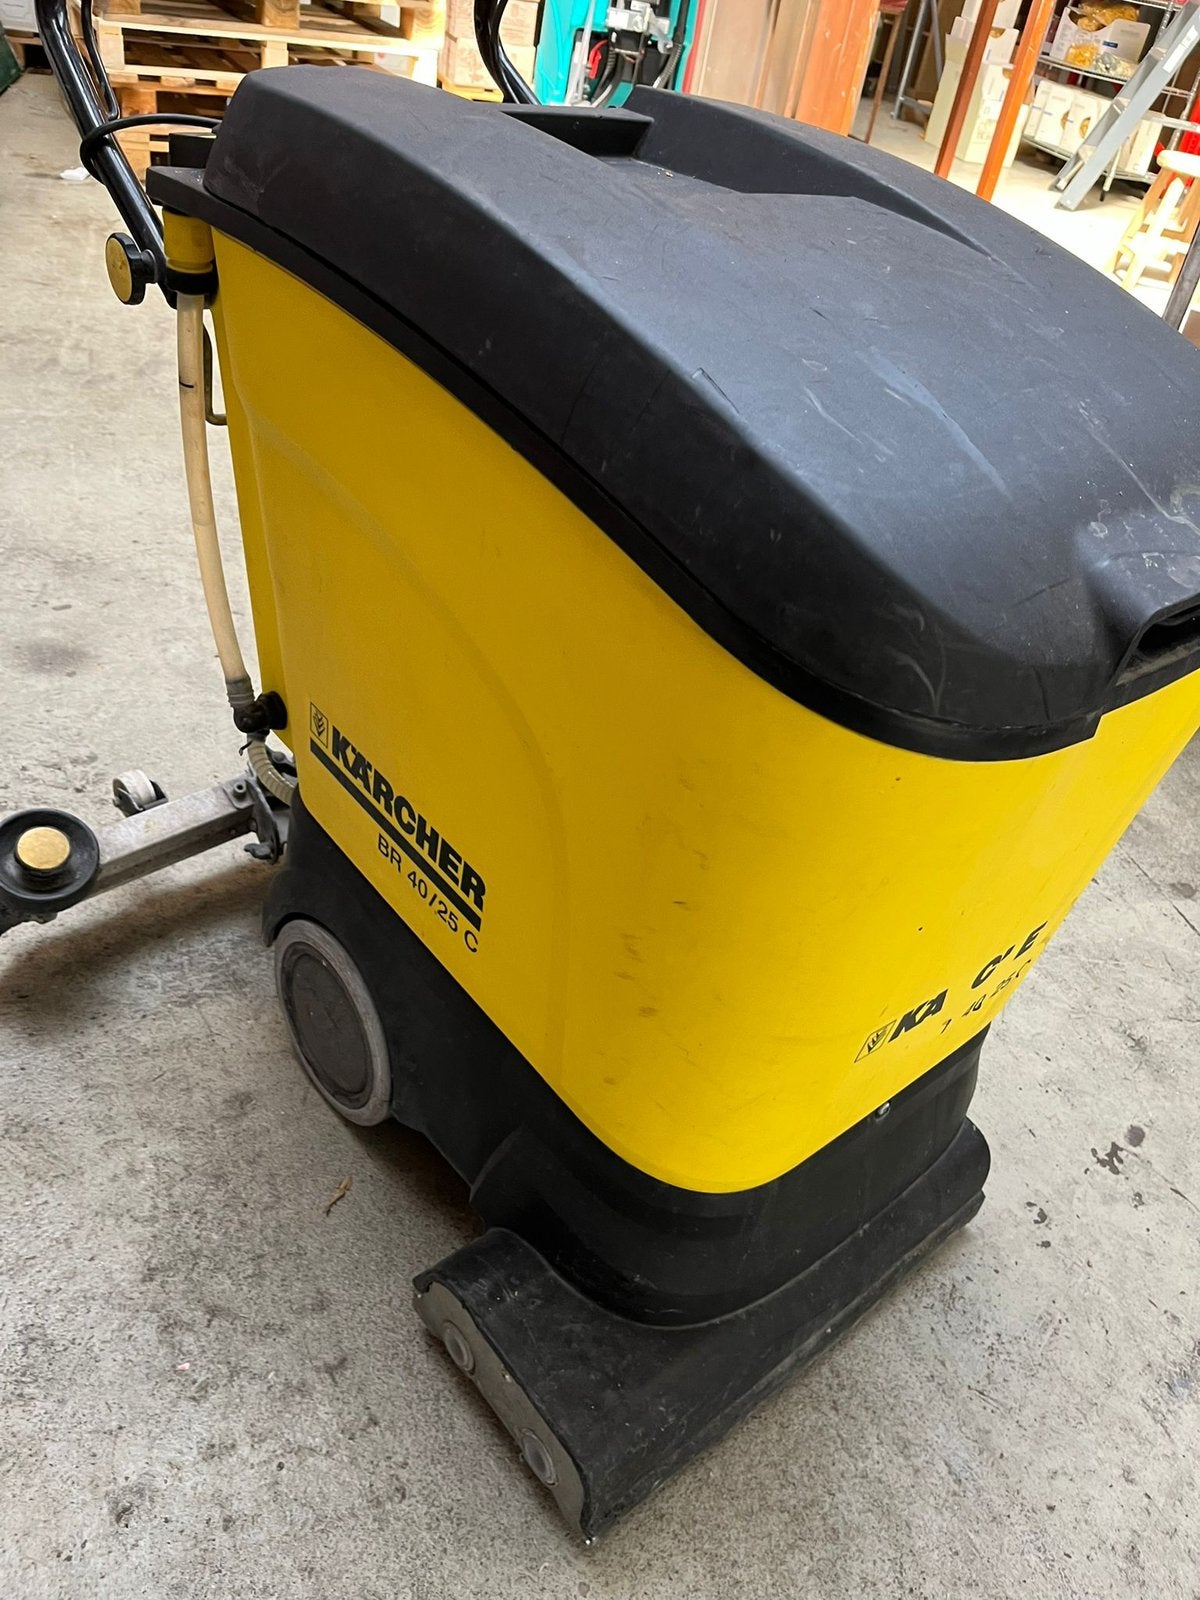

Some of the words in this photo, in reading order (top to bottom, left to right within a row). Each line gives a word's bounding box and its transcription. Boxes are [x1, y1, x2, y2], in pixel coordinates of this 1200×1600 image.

[332, 725, 486, 912] KÄRCHER
[378, 833, 402, 873] BR
[407, 870, 459, 933] 40/25
[464, 930, 479, 953] C
